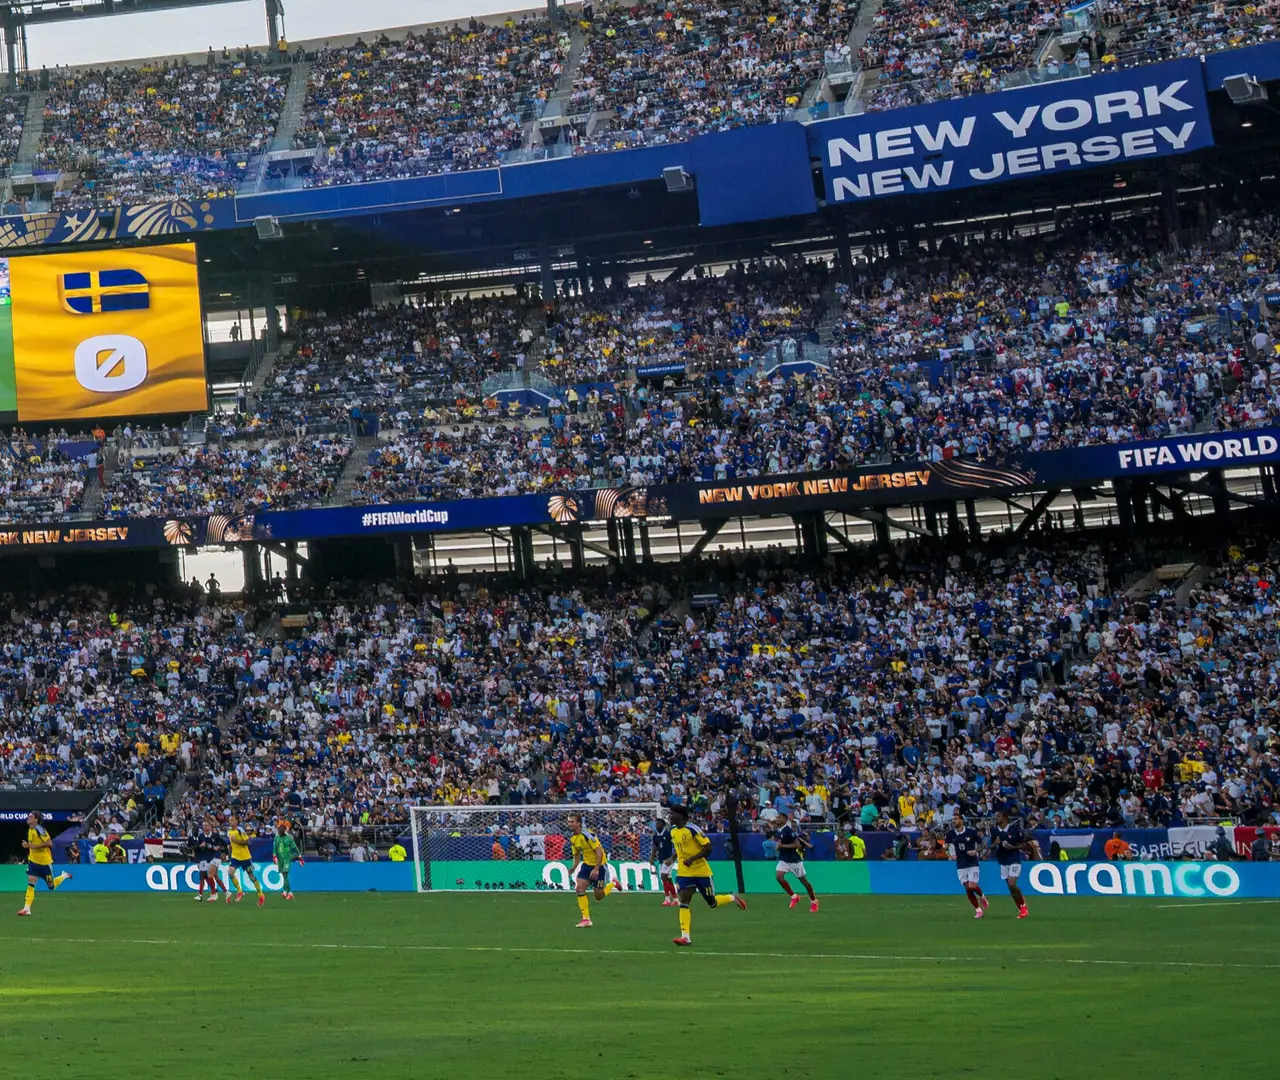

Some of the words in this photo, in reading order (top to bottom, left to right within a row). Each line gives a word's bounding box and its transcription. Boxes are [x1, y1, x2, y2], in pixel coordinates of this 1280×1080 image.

[828, 116, 976, 167] NEW
[992, 79, 1194, 138] YORK
[833, 160, 954, 201] NEW
[969, 121, 1196, 180] JERSEY
[1118, 446, 1176, 468] FIFA
[1177, 435, 1278, 462] WORLD
[699, 487, 743, 504] NEW
[746, 481, 801, 500] YORK
[803, 478, 848, 495] NEW
[852, 471, 930, 491] JERSEY
[362, 509, 448, 526] #FIFAWorldCup
[22, 529, 60, 544] NEW
[63, 527, 129, 542] JERSEY
[1029, 862, 1240, 896] aramco
